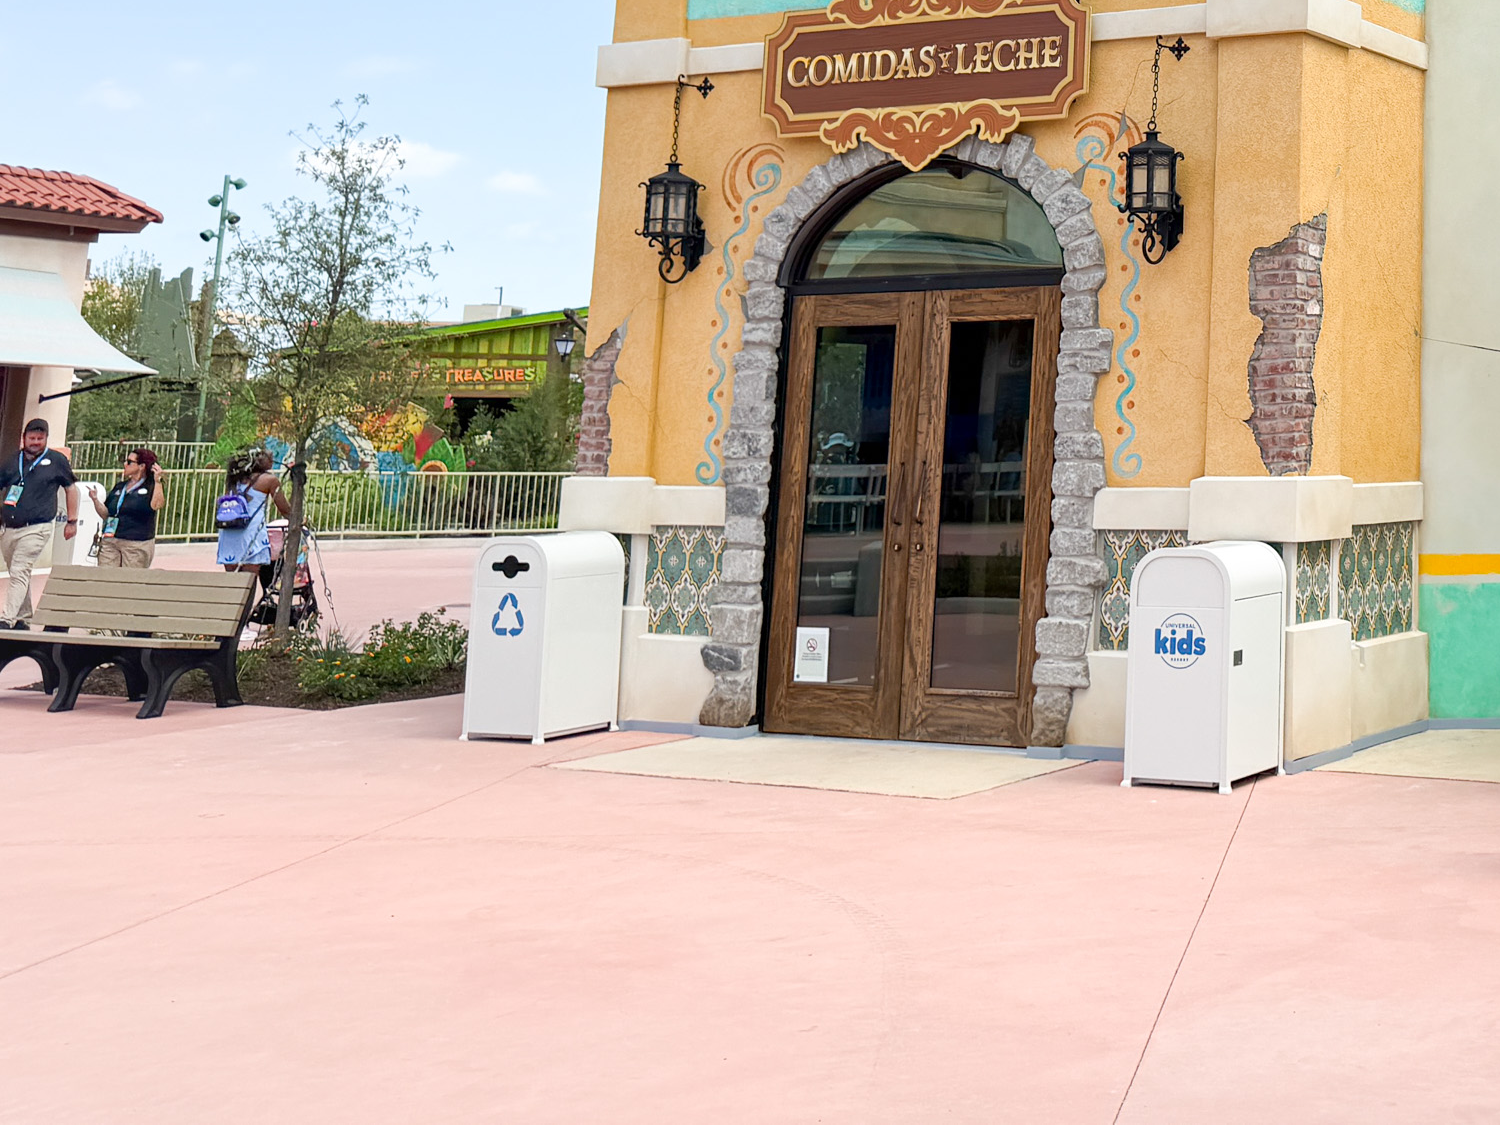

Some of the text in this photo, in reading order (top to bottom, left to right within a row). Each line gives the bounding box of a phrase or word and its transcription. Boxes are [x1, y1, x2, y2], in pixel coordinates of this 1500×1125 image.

[787, 44, 937, 87] COMIDAS
[954, 36, 1063, 74] LECHE
[1154, 628, 1206, 656] kids
